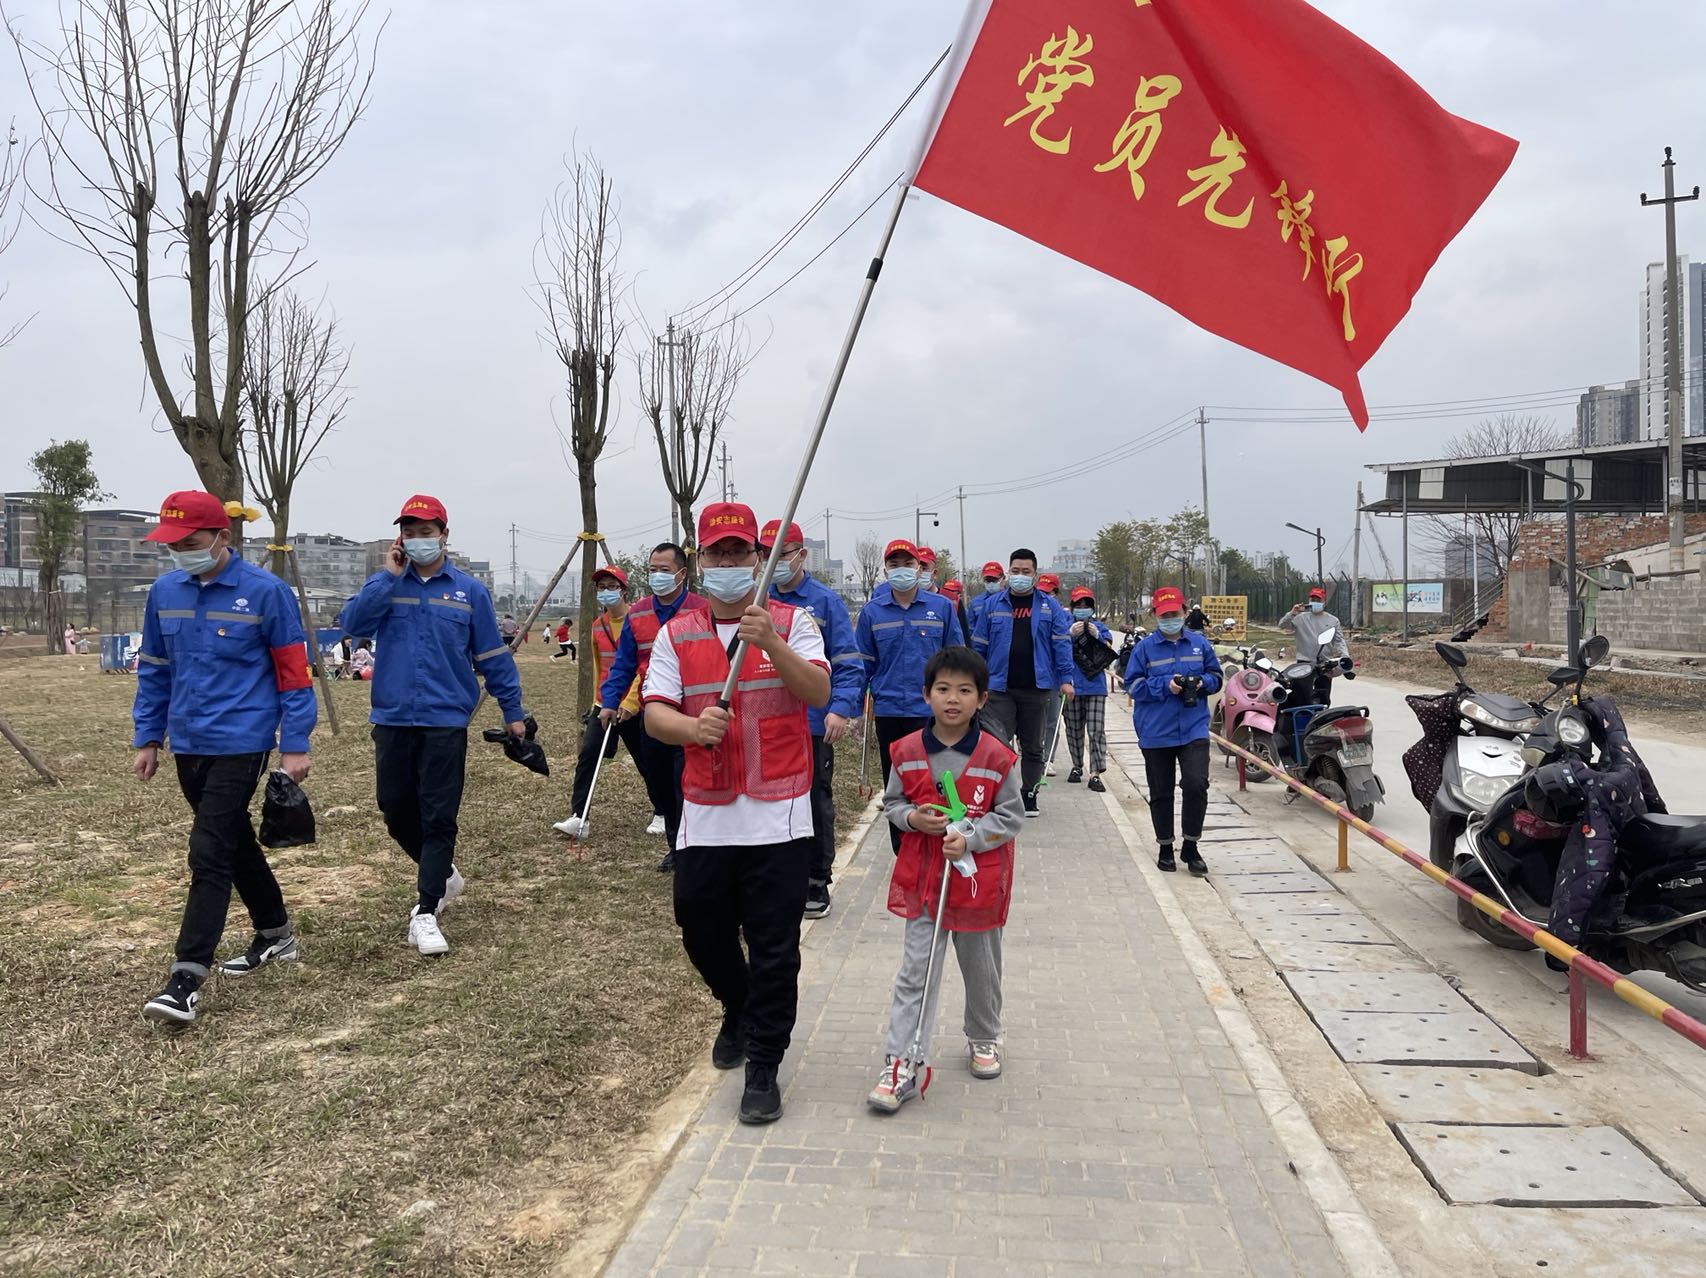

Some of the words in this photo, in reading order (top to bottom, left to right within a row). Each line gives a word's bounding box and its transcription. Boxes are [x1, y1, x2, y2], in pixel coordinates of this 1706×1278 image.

[1003, 25, 1364, 342] 党员先锋队
